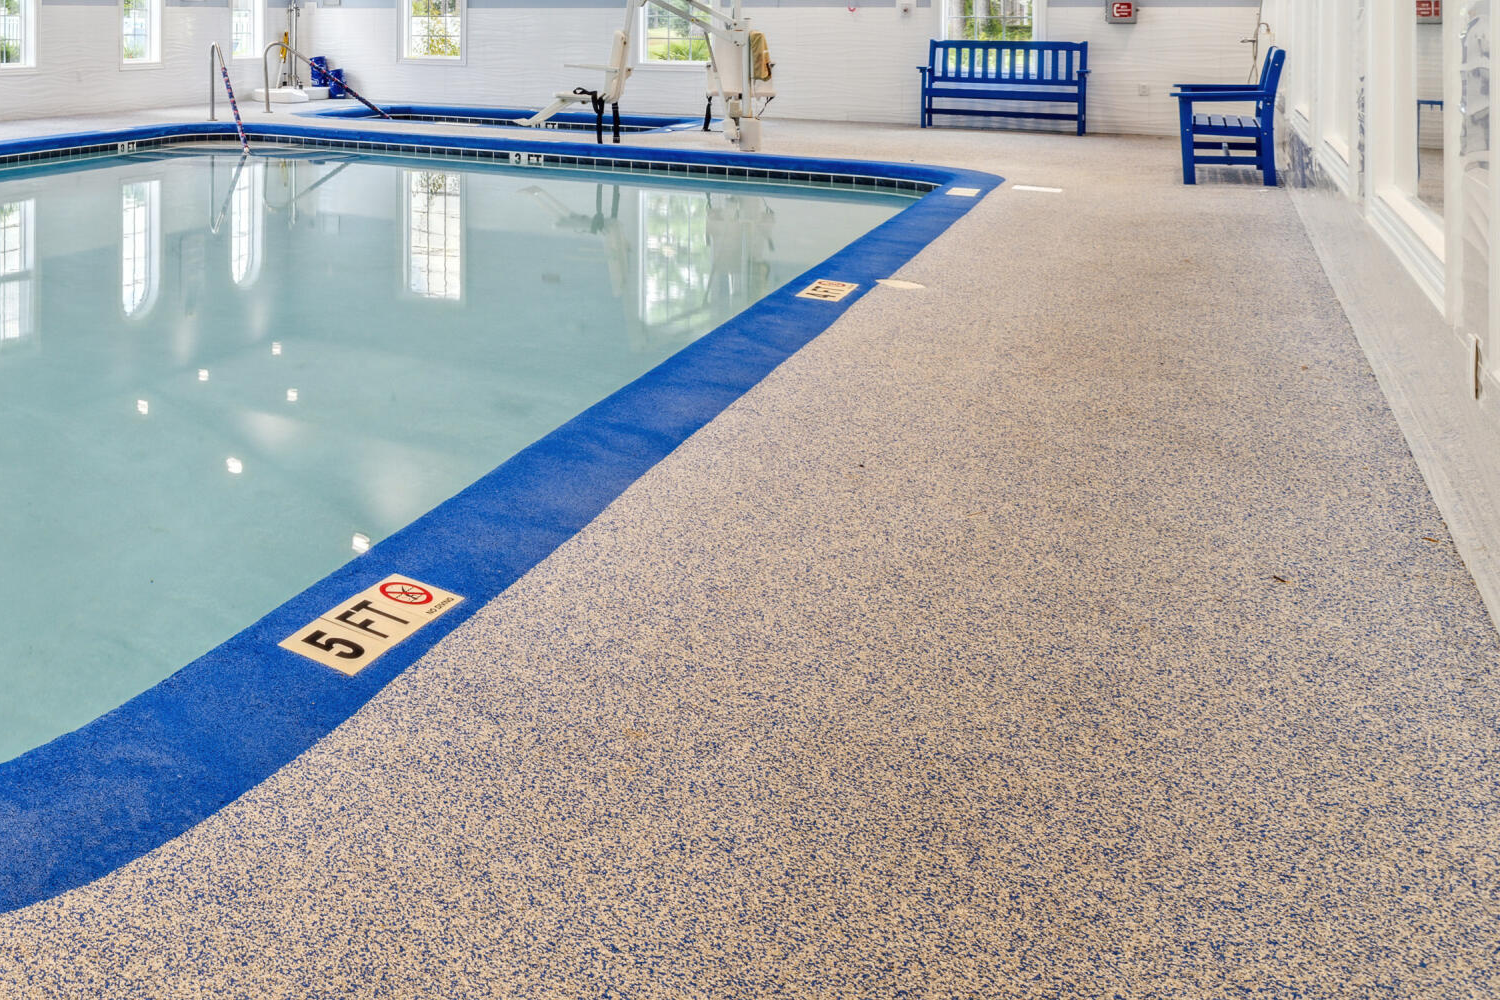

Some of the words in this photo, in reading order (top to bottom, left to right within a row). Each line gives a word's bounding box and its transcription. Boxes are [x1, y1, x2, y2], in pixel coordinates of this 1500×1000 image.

[528, 153, 542, 162] FT
[425, 607, 438, 615] NO
[435, 597, 455, 610] DIVING
[301, 629, 365, 659] 5
[334, 600, 410, 639] FT
